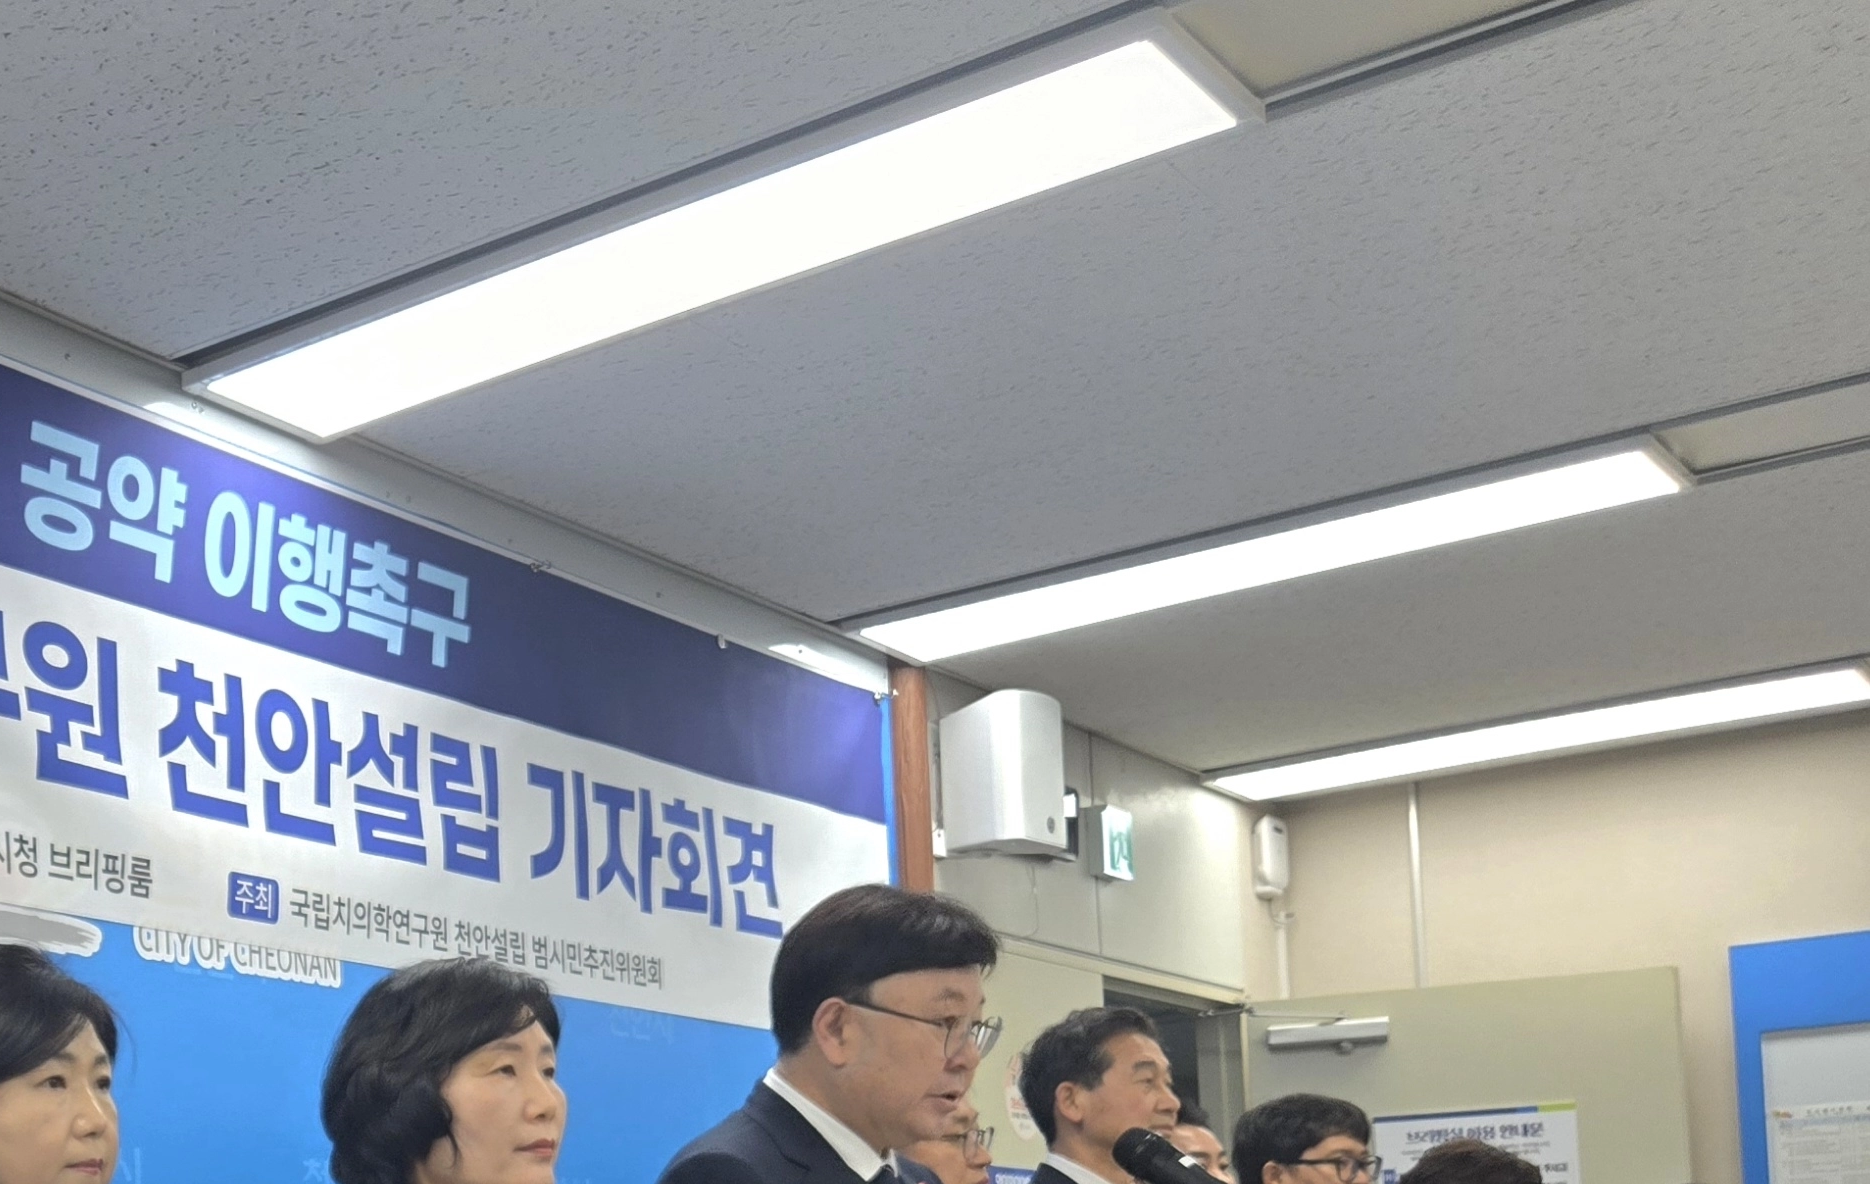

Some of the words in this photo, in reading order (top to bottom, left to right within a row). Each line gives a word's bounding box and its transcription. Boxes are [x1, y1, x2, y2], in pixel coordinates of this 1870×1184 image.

[20, 419, 188, 583] 공약
[204, 489, 472, 670] 이행촉구
[157, 658, 502, 883] 천안설립
[526, 760, 785, 940] 기자회견
[48, 842, 153, 900] 브리핑룸
[233, 942, 338, 982] CHEONAN
[234, 880, 273, 918] 주최
[289, 888, 448, 949] 국립치의학연구원
[454, 920, 526, 967] 천안설립
[532, 936, 664, 990] 범시민추진위원회
